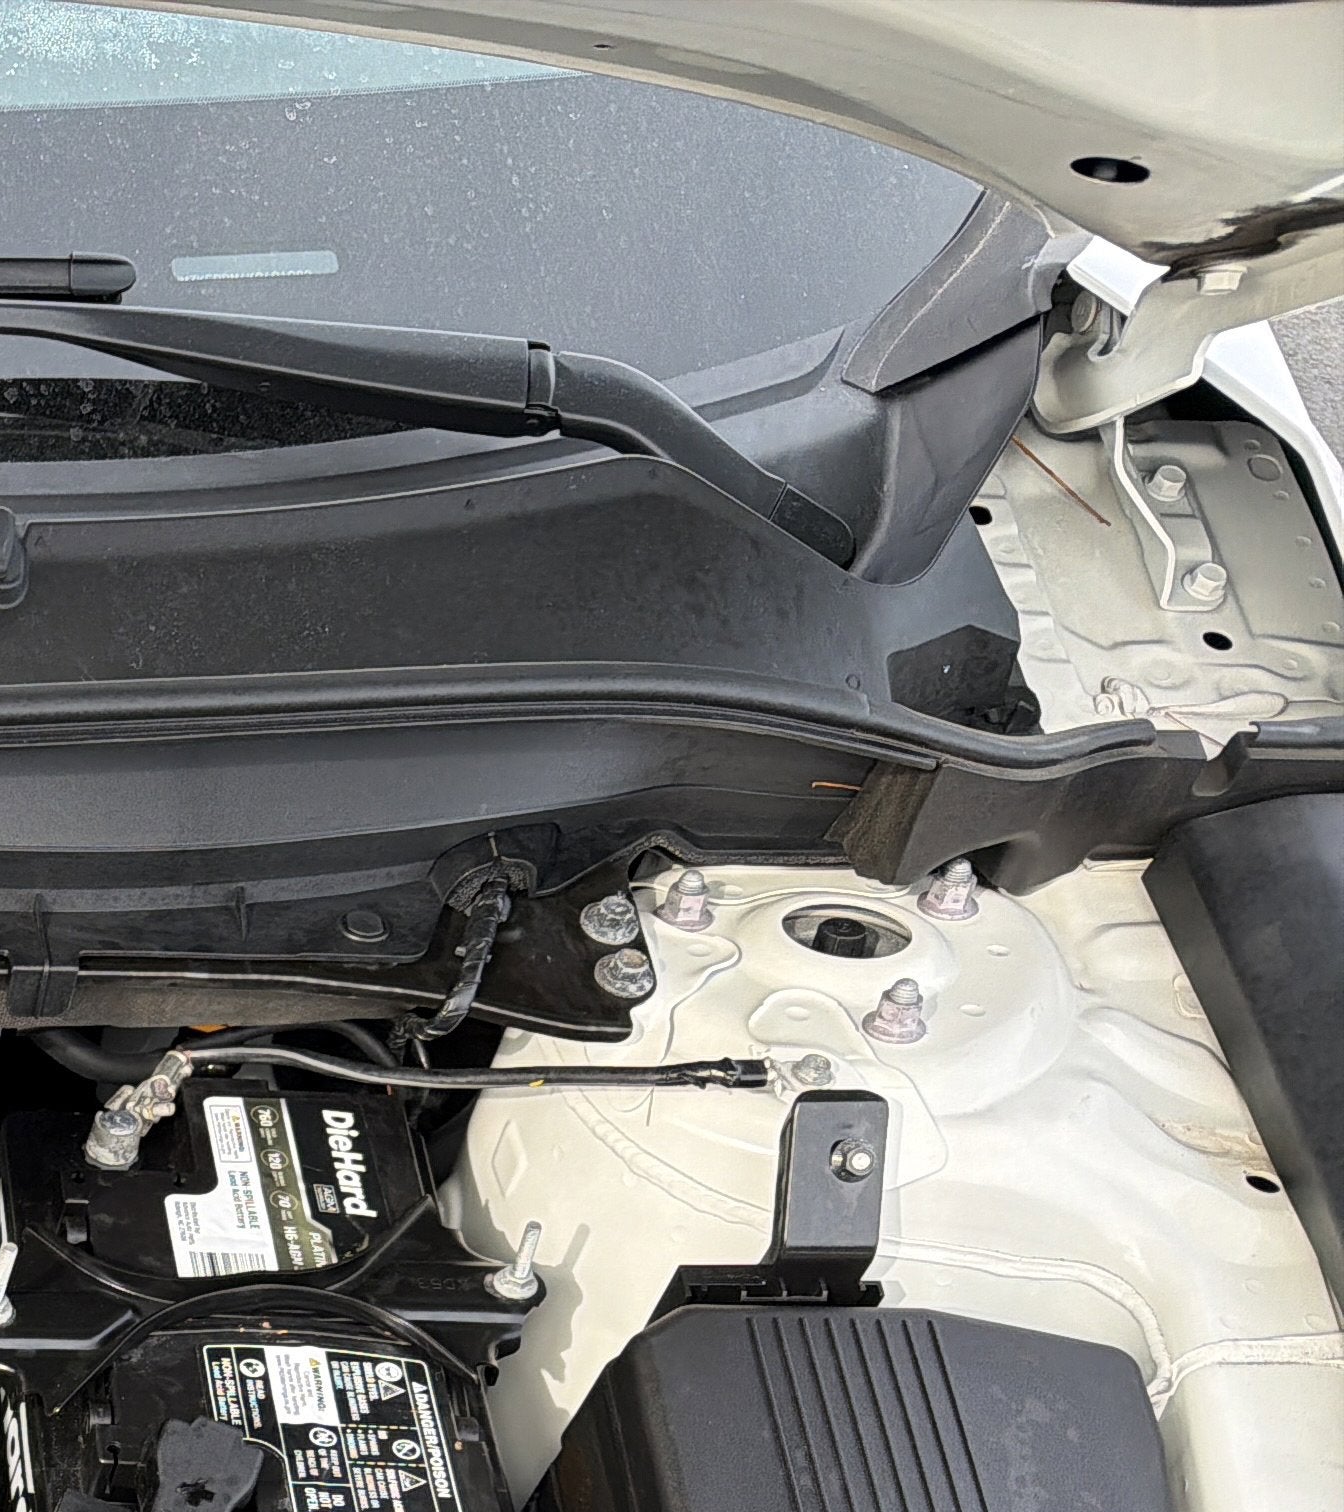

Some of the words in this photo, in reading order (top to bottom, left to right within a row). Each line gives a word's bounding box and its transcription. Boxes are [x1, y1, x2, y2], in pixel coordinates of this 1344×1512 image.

[256, 1108, 273, 1127] 760
[266, 1152, 283, 1169] 120
[321, 1109, 378, 1218] DieHard
[238, 1170, 260, 1229] NON-SPILLABLE
[276, 1194, 292, 1208] 70
[322, 1187, 337, 1211] AGM
[219, 1357, 243, 1426] NON-SPILLABLE
[253, 1379, 267, 1399] READ
[309, 1366, 328, 1412] WARNING:
[413, 1392, 451, 1498] DANGER/POISON
[303, 1486, 321, 1512] OPEN.
[317, 1490, 333, 1509] NOT
[330, 1493, 346, 1507] DO
